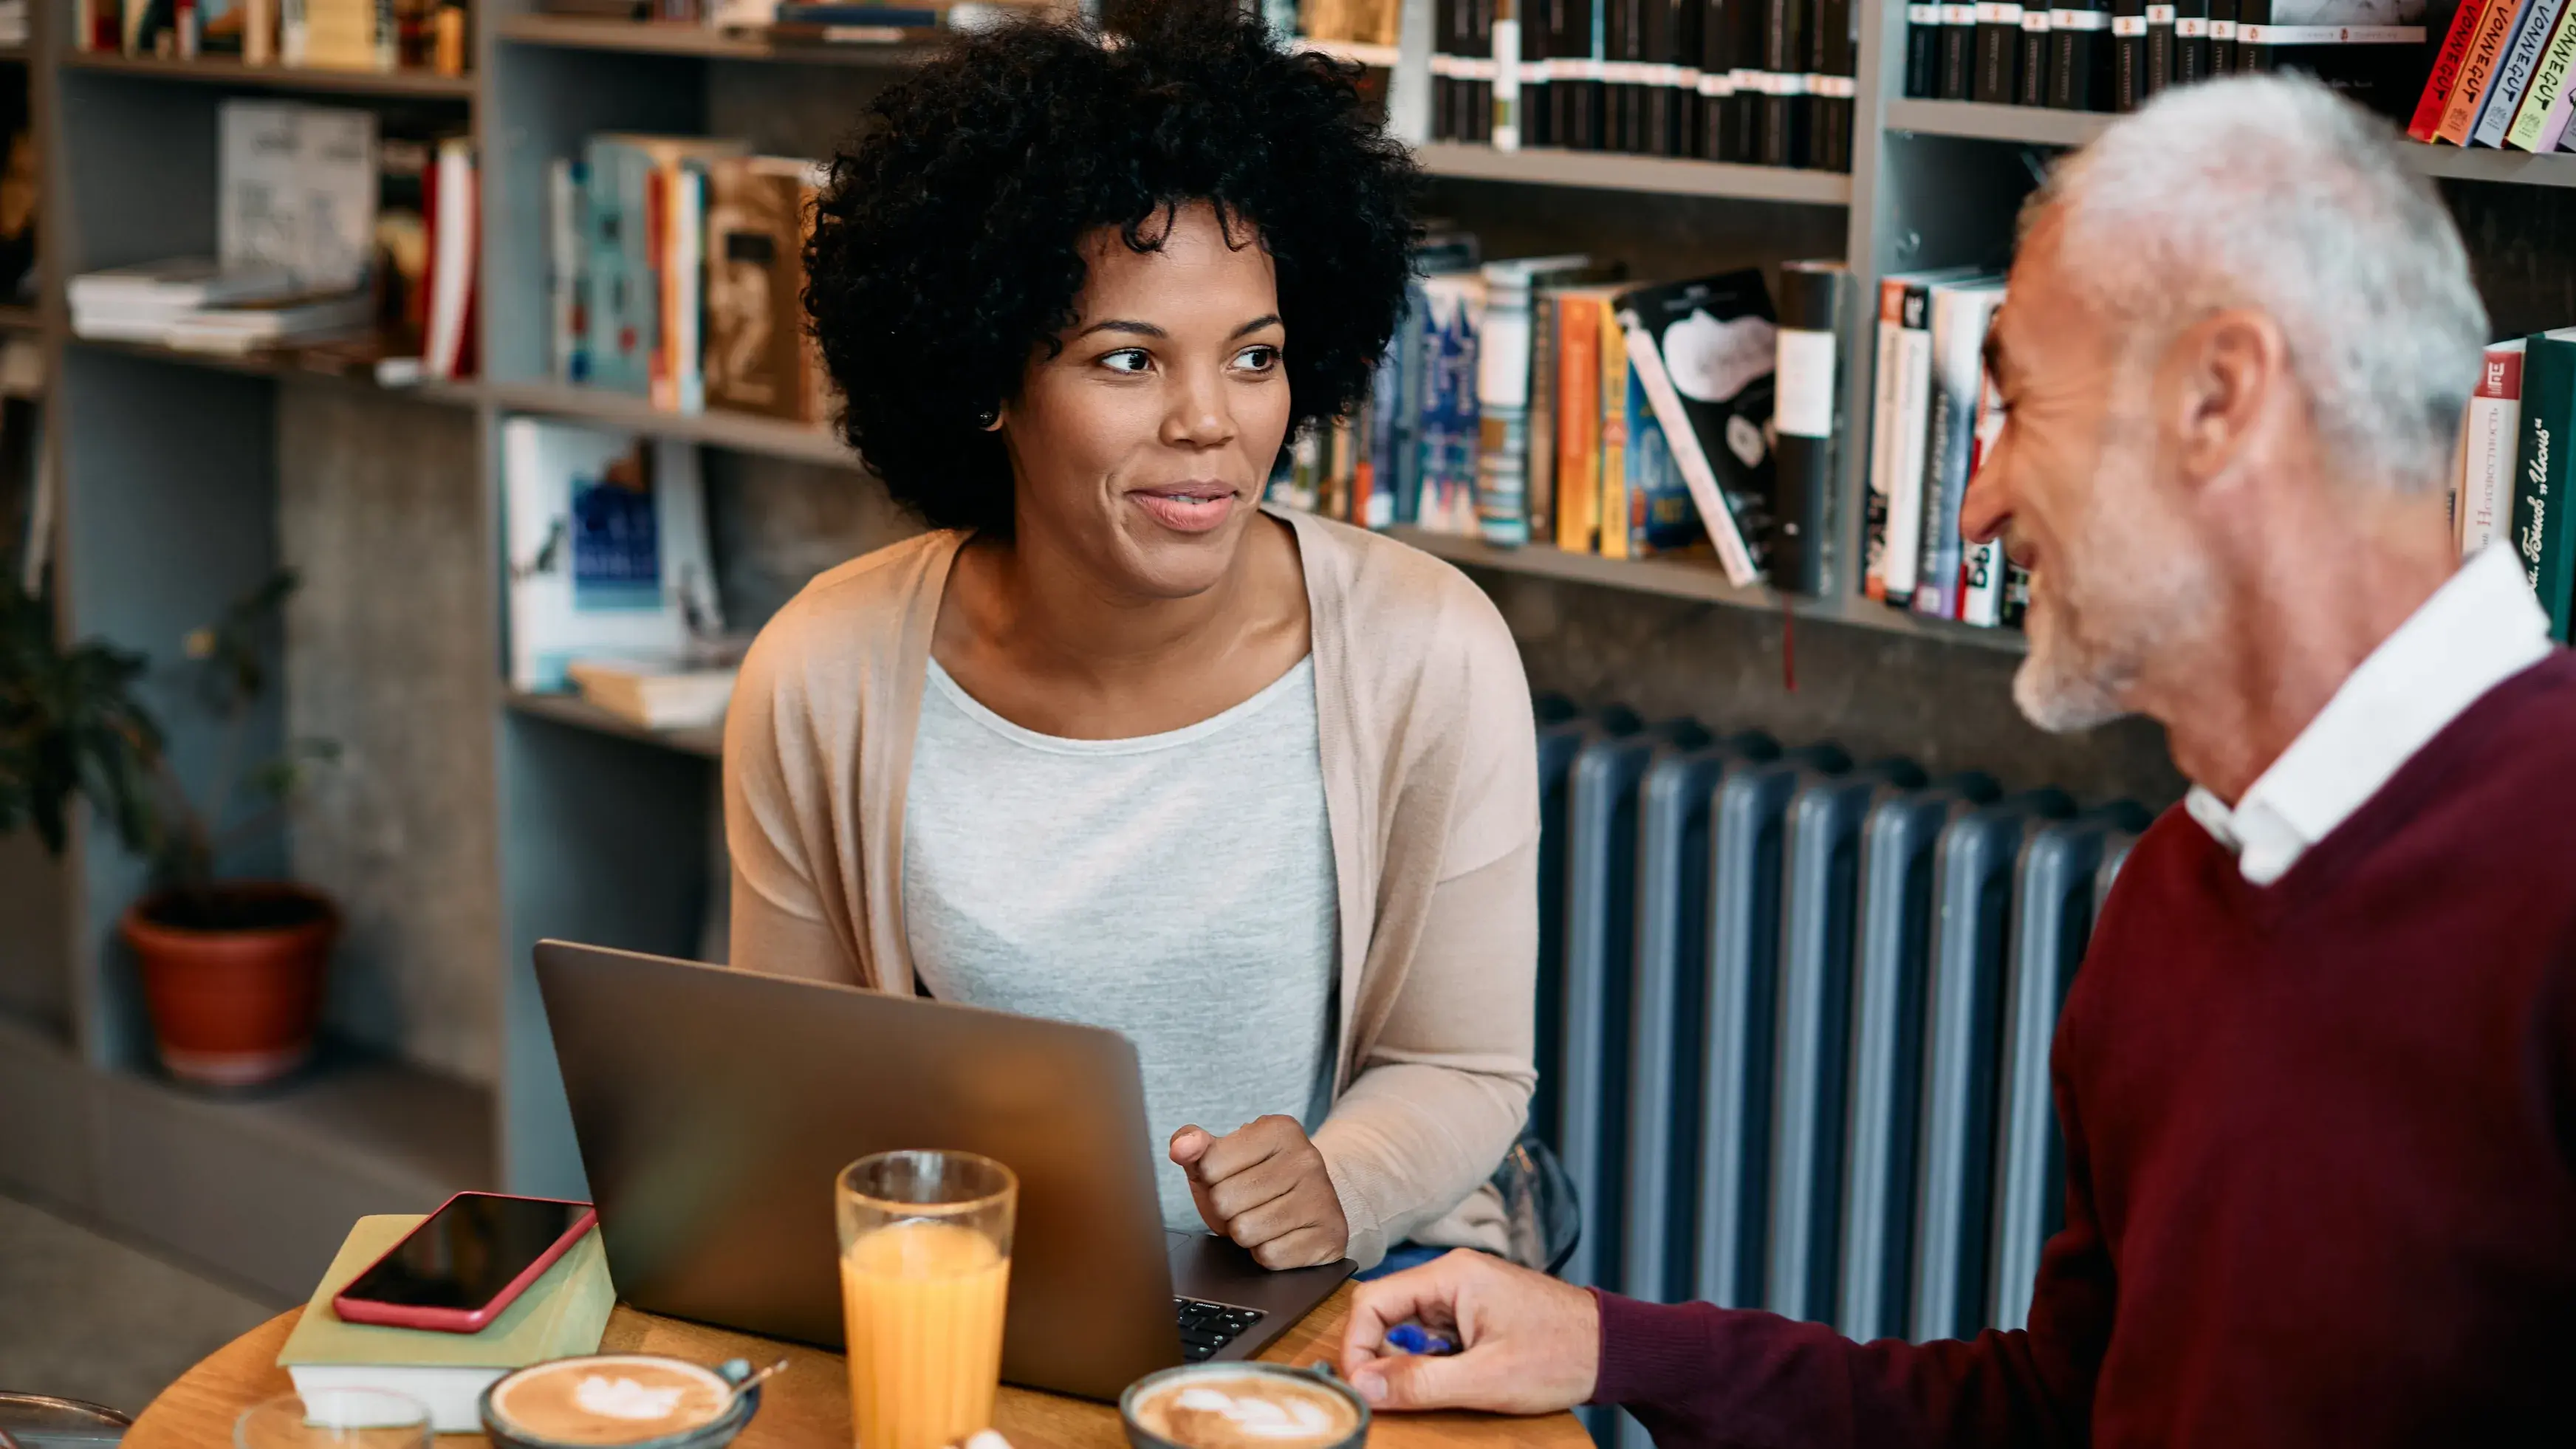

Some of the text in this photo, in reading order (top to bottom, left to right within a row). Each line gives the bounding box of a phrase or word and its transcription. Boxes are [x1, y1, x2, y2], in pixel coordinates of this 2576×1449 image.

[2432, 4, 2478, 101] VONNEGUT
[2462, 5, 2509, 104] VONNEGUT
[2501, 4, 2551, 103] VONNEGUT
[2522, 496, 2545, 564] Быков
